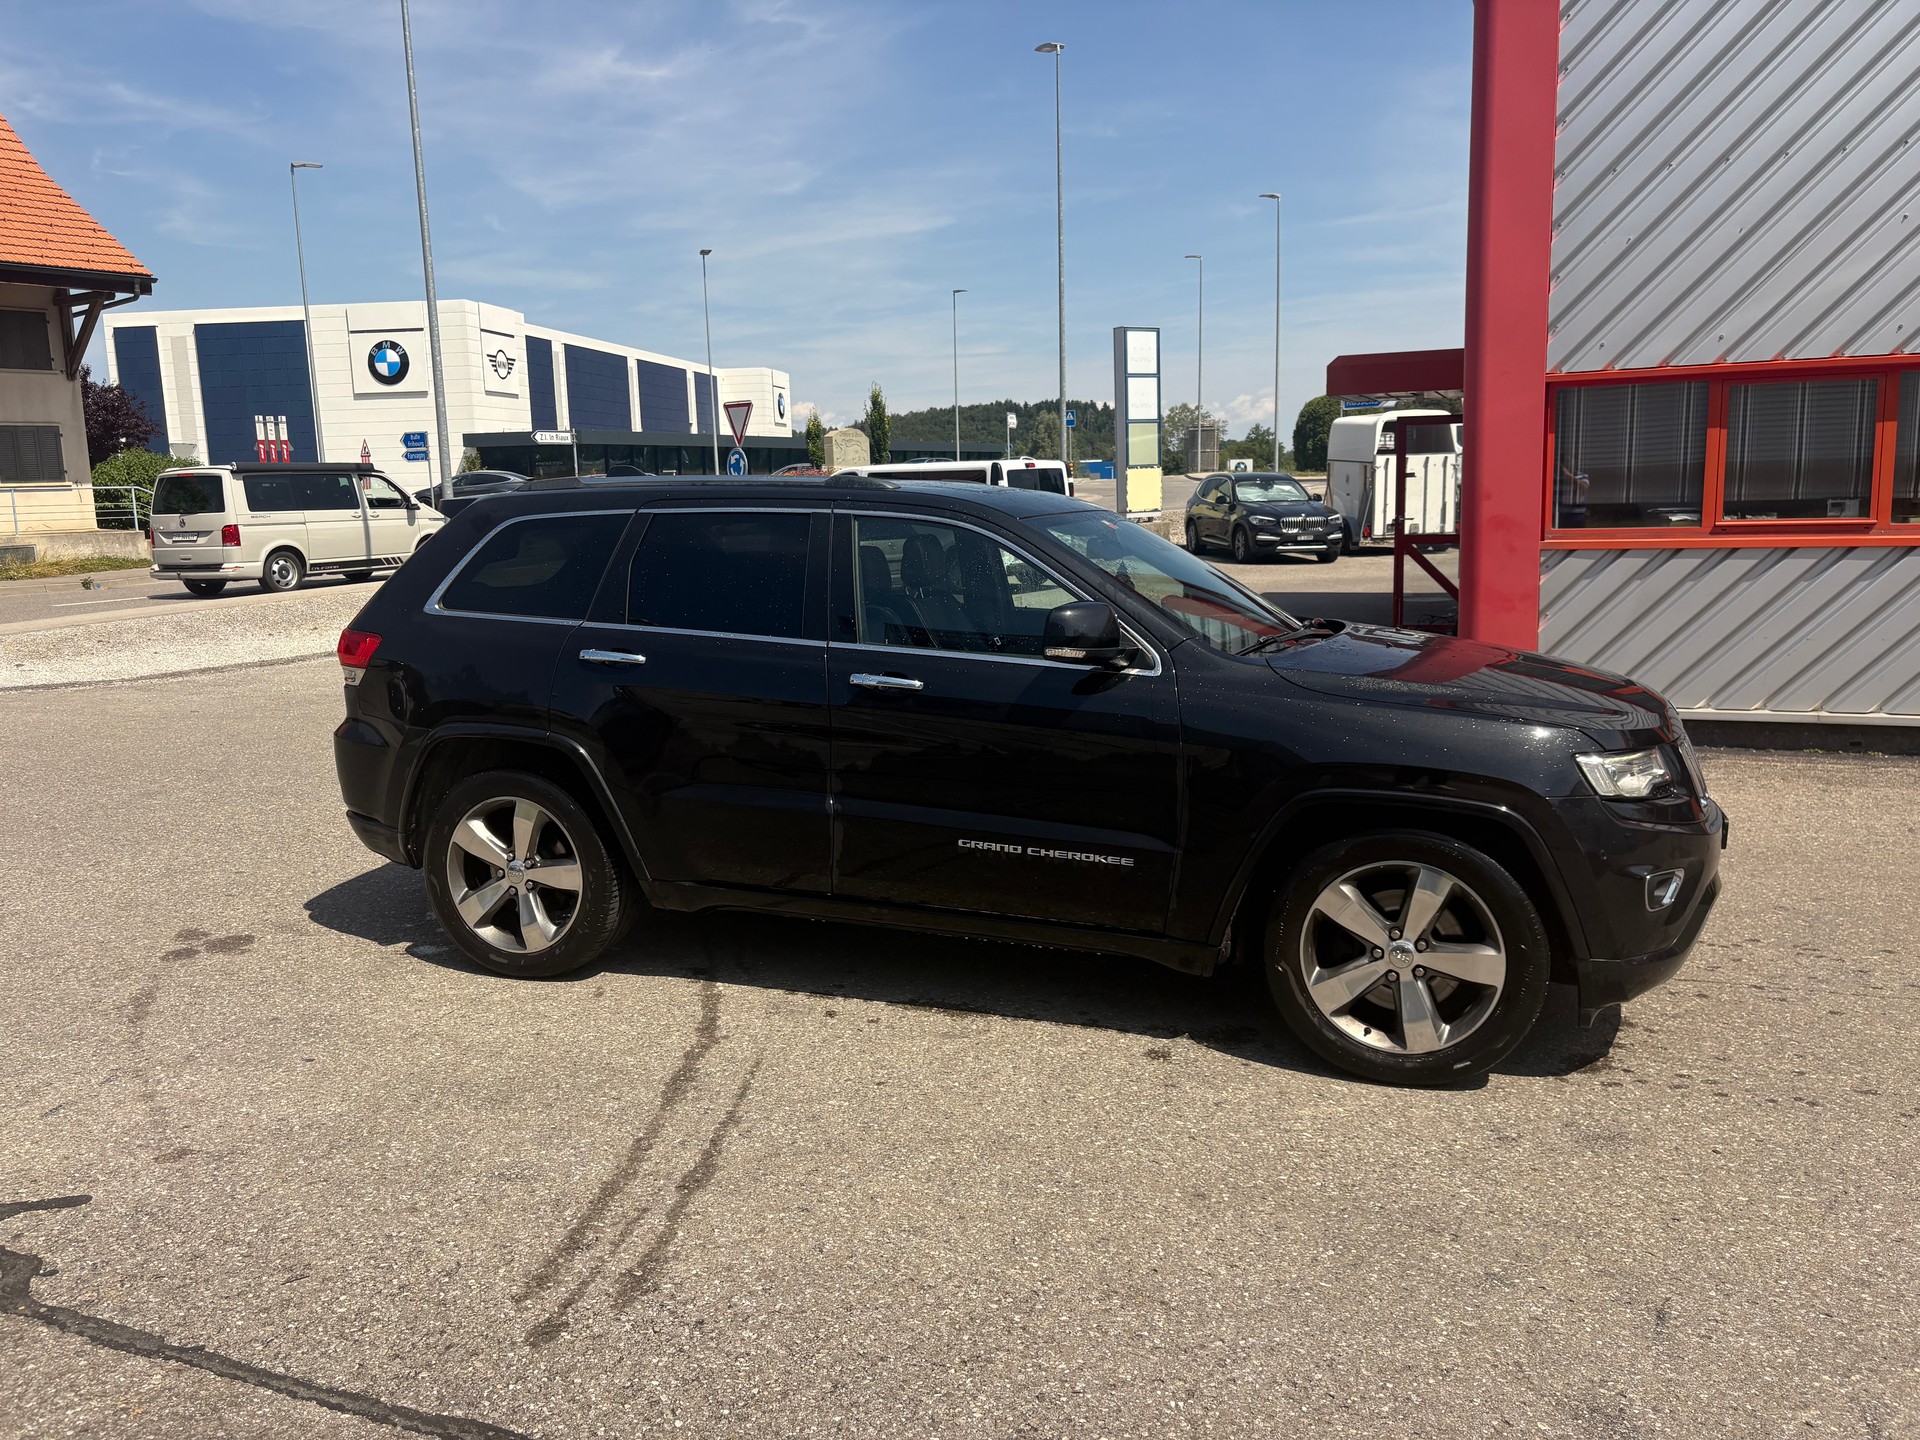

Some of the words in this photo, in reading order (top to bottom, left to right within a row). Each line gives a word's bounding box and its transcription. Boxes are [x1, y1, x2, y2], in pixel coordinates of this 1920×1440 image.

[371, 341, 405, 356] BMW
[958, 839, 1022, 854] GRAND
[1027, 847, 1134, 867] CHEROKEE
